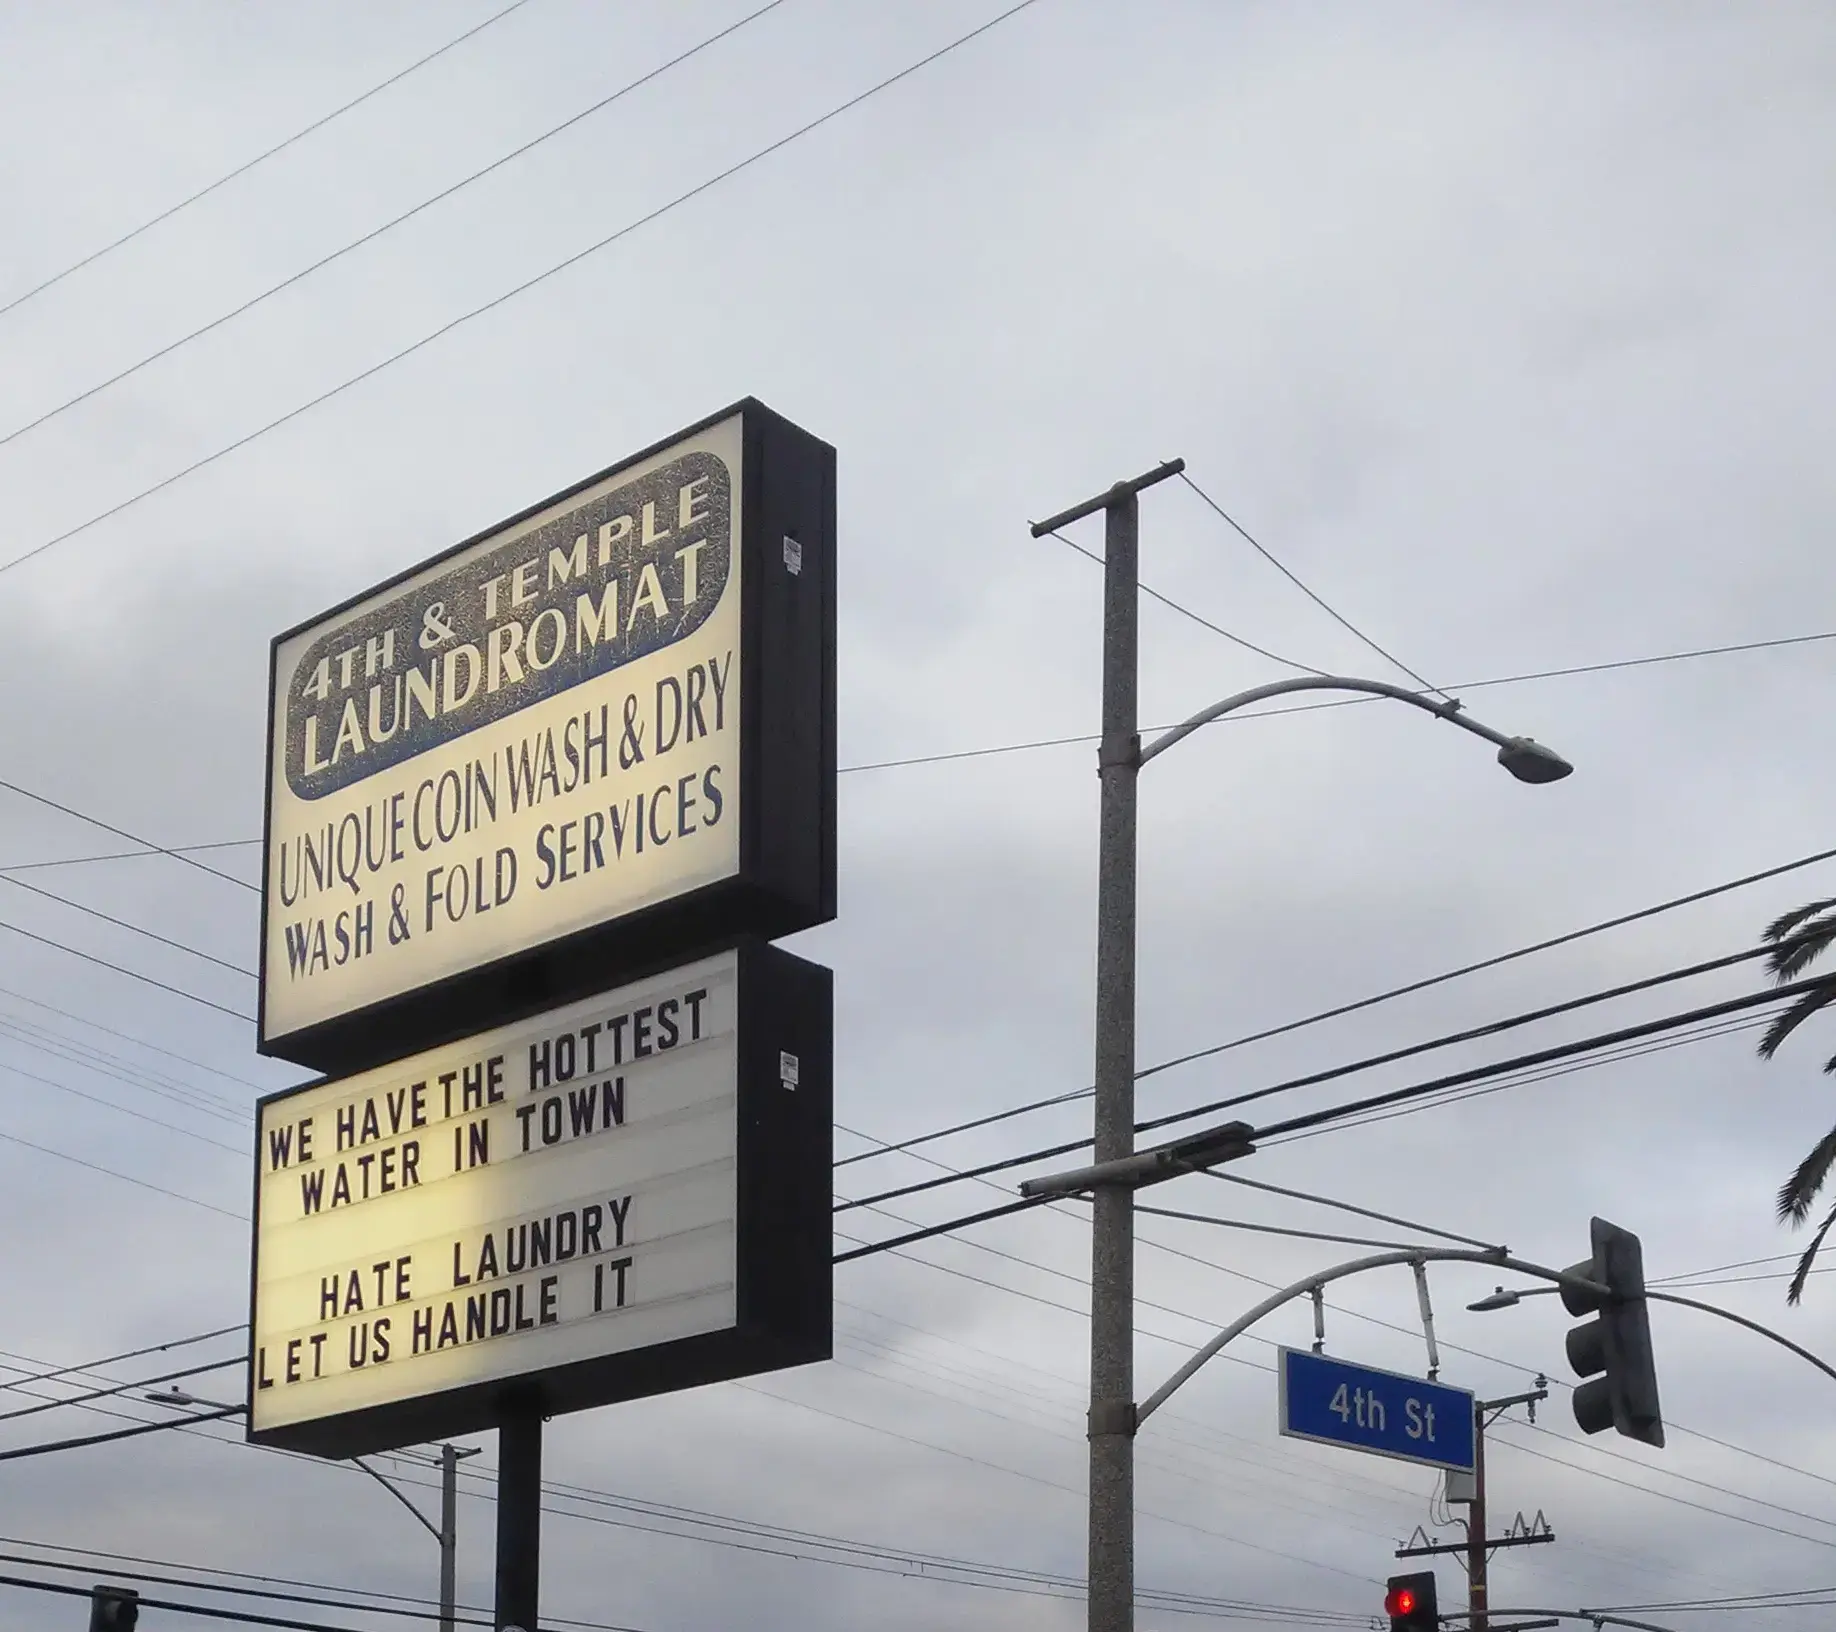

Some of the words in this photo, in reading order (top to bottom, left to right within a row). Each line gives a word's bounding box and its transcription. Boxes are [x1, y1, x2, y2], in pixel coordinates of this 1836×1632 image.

[302, 538, 708, 779] LAUNDROMAT
[303, 630, 393, 700] 4TH
[419, 601, 452, 650] &
[479, 476, 711, 621] TEMPLE
[280, 792, 405, 908] UNIQUE
[413, 752, 498, 853] COIN
[505, 716, 608, 815] WASH
[619, 692, 646, 771] &
[655, 649, 734, 755] DRY
[284, 900, 373, 982] WASH
[388, 883, 411, 945] &
[425, 846, 518, 933] FOLD
[535, 763, 724, 889] SERVICES
[268, 1117, 314, 1171] WE
[335, 1081, 428, 1152] HAVE
[438, 1055, 505, 1119] THE
[529, 989, 708, 1093] HOTTEST
[300, 1140, 420, 1215] WATER
[454, 1118, 489, 1172] IN
[515, 1076, 625, 1152] TOWN
[258, 1332, 328, 1391] LET
[348, 1317, 391, 1369] US
[411, 1276, 559, 1355] HANDLE
[593, 1256, 633, 1312] IT
[320, 1255, 412, 1321] HATE
[453, 1196, 633, 1288] LAUNDRY
[1329, 1383, 1385, 1431] 4th
[1405, 1397, 1436, 1443] St
